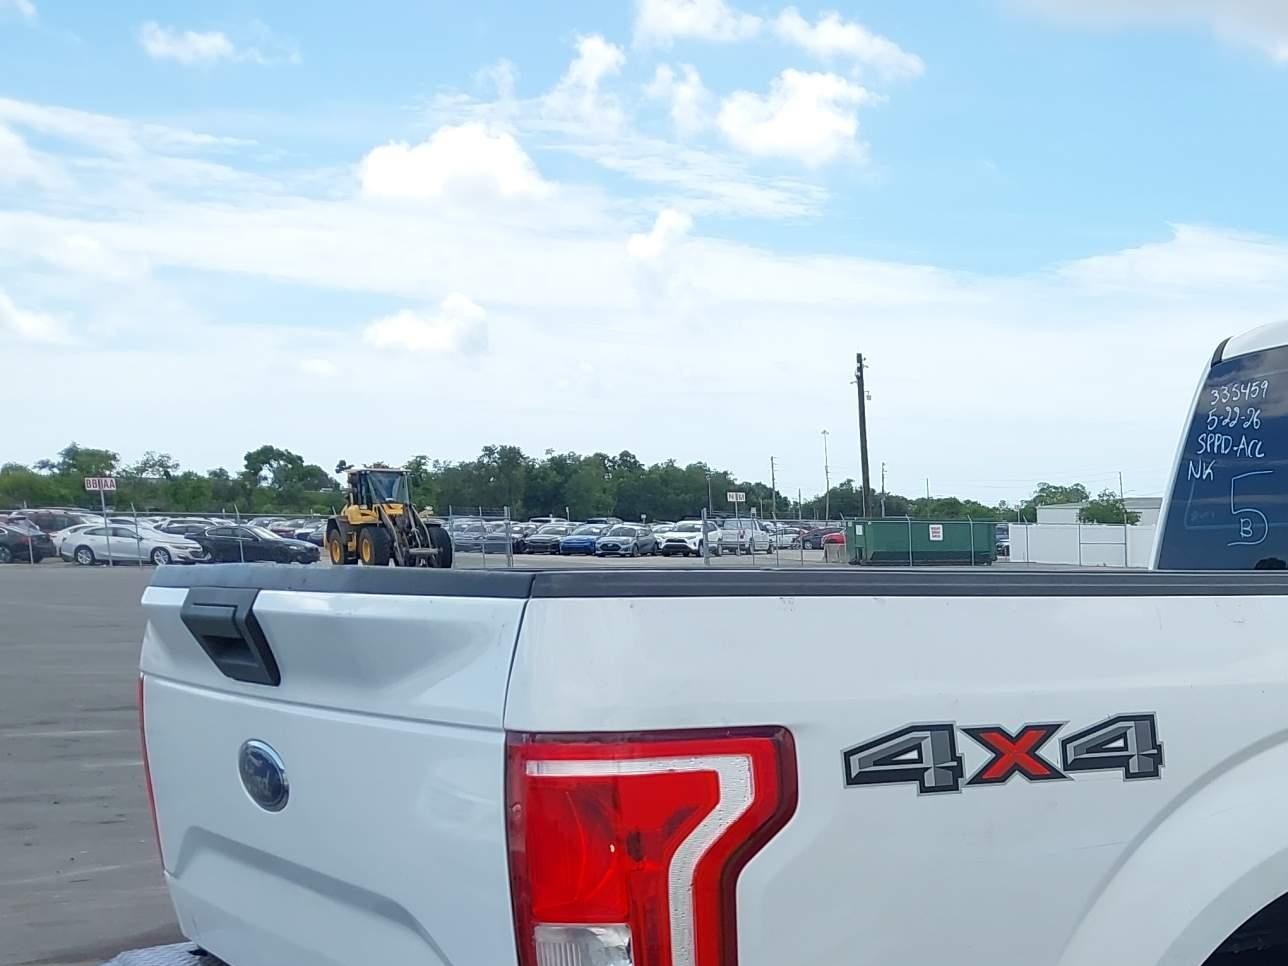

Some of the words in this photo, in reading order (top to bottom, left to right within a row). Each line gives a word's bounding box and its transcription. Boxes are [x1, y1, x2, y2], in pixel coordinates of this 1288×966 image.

[1211, 380, 1269, 406] 335459
[1206, 406, 1261, 431] 5-22-26
[1187, 459, 1216, 481] NK
[1240, 518, 1253, 538] B
[841, 711, 1166, 797] 4X4
